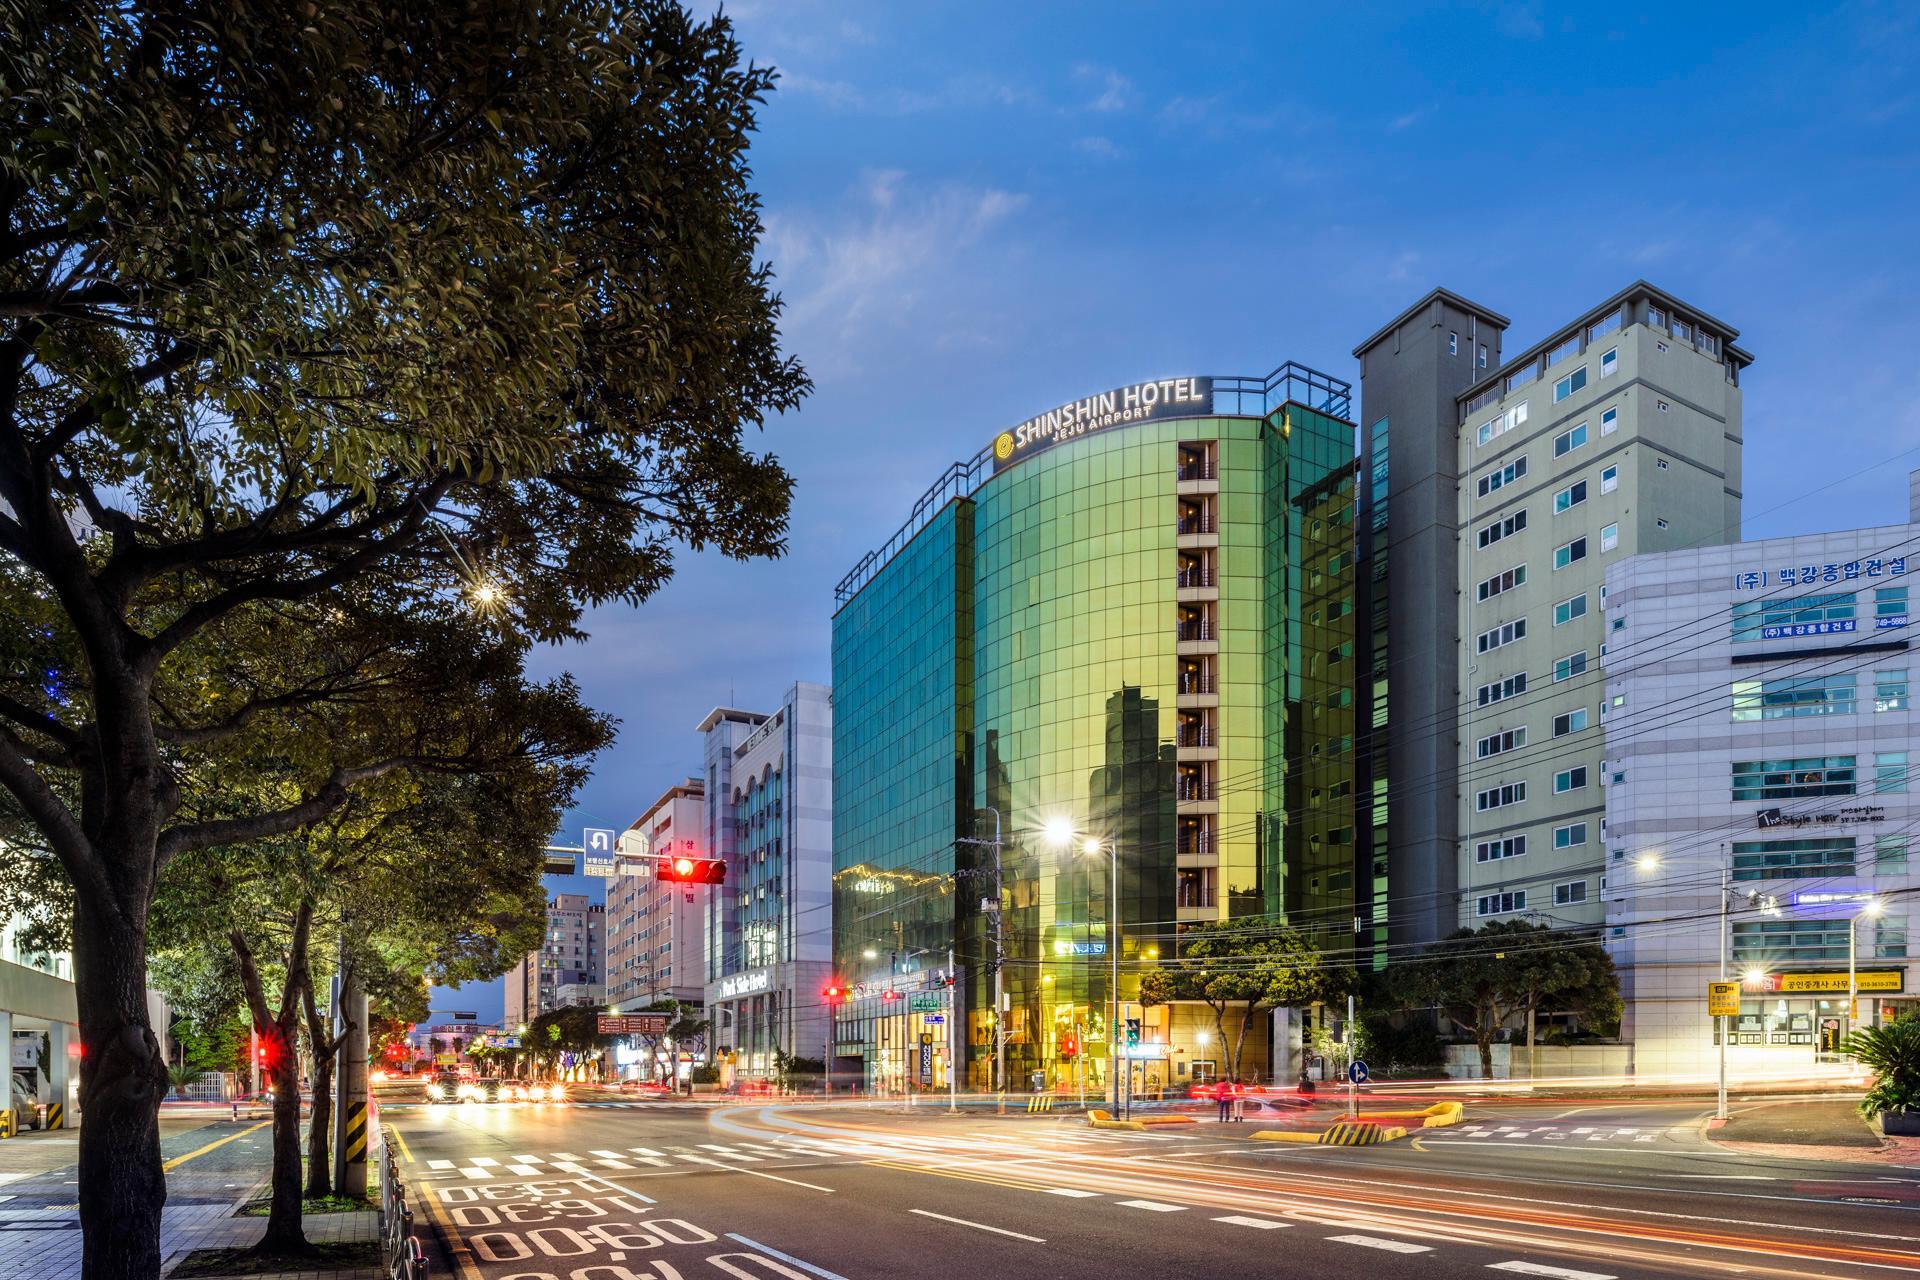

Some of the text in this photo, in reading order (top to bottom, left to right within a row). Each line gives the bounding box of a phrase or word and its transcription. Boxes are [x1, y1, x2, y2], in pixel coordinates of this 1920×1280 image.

[1015, 378, 1203, 449] SHINSHIN HOTEL
[1052, 406, 1152, 442] JEJU AIRPORT
[1780, 557, 1907, 586] 백강종합건설
[1783, 620, 1853, 636] 백강종합건설
[1758, 811, 1780, 827] The
[722, 969, 767, 998] Park Side Hotel
[1788, 980, 1829, 989] 공인중개사
[469, 1218, 718, 1262] 09:00
